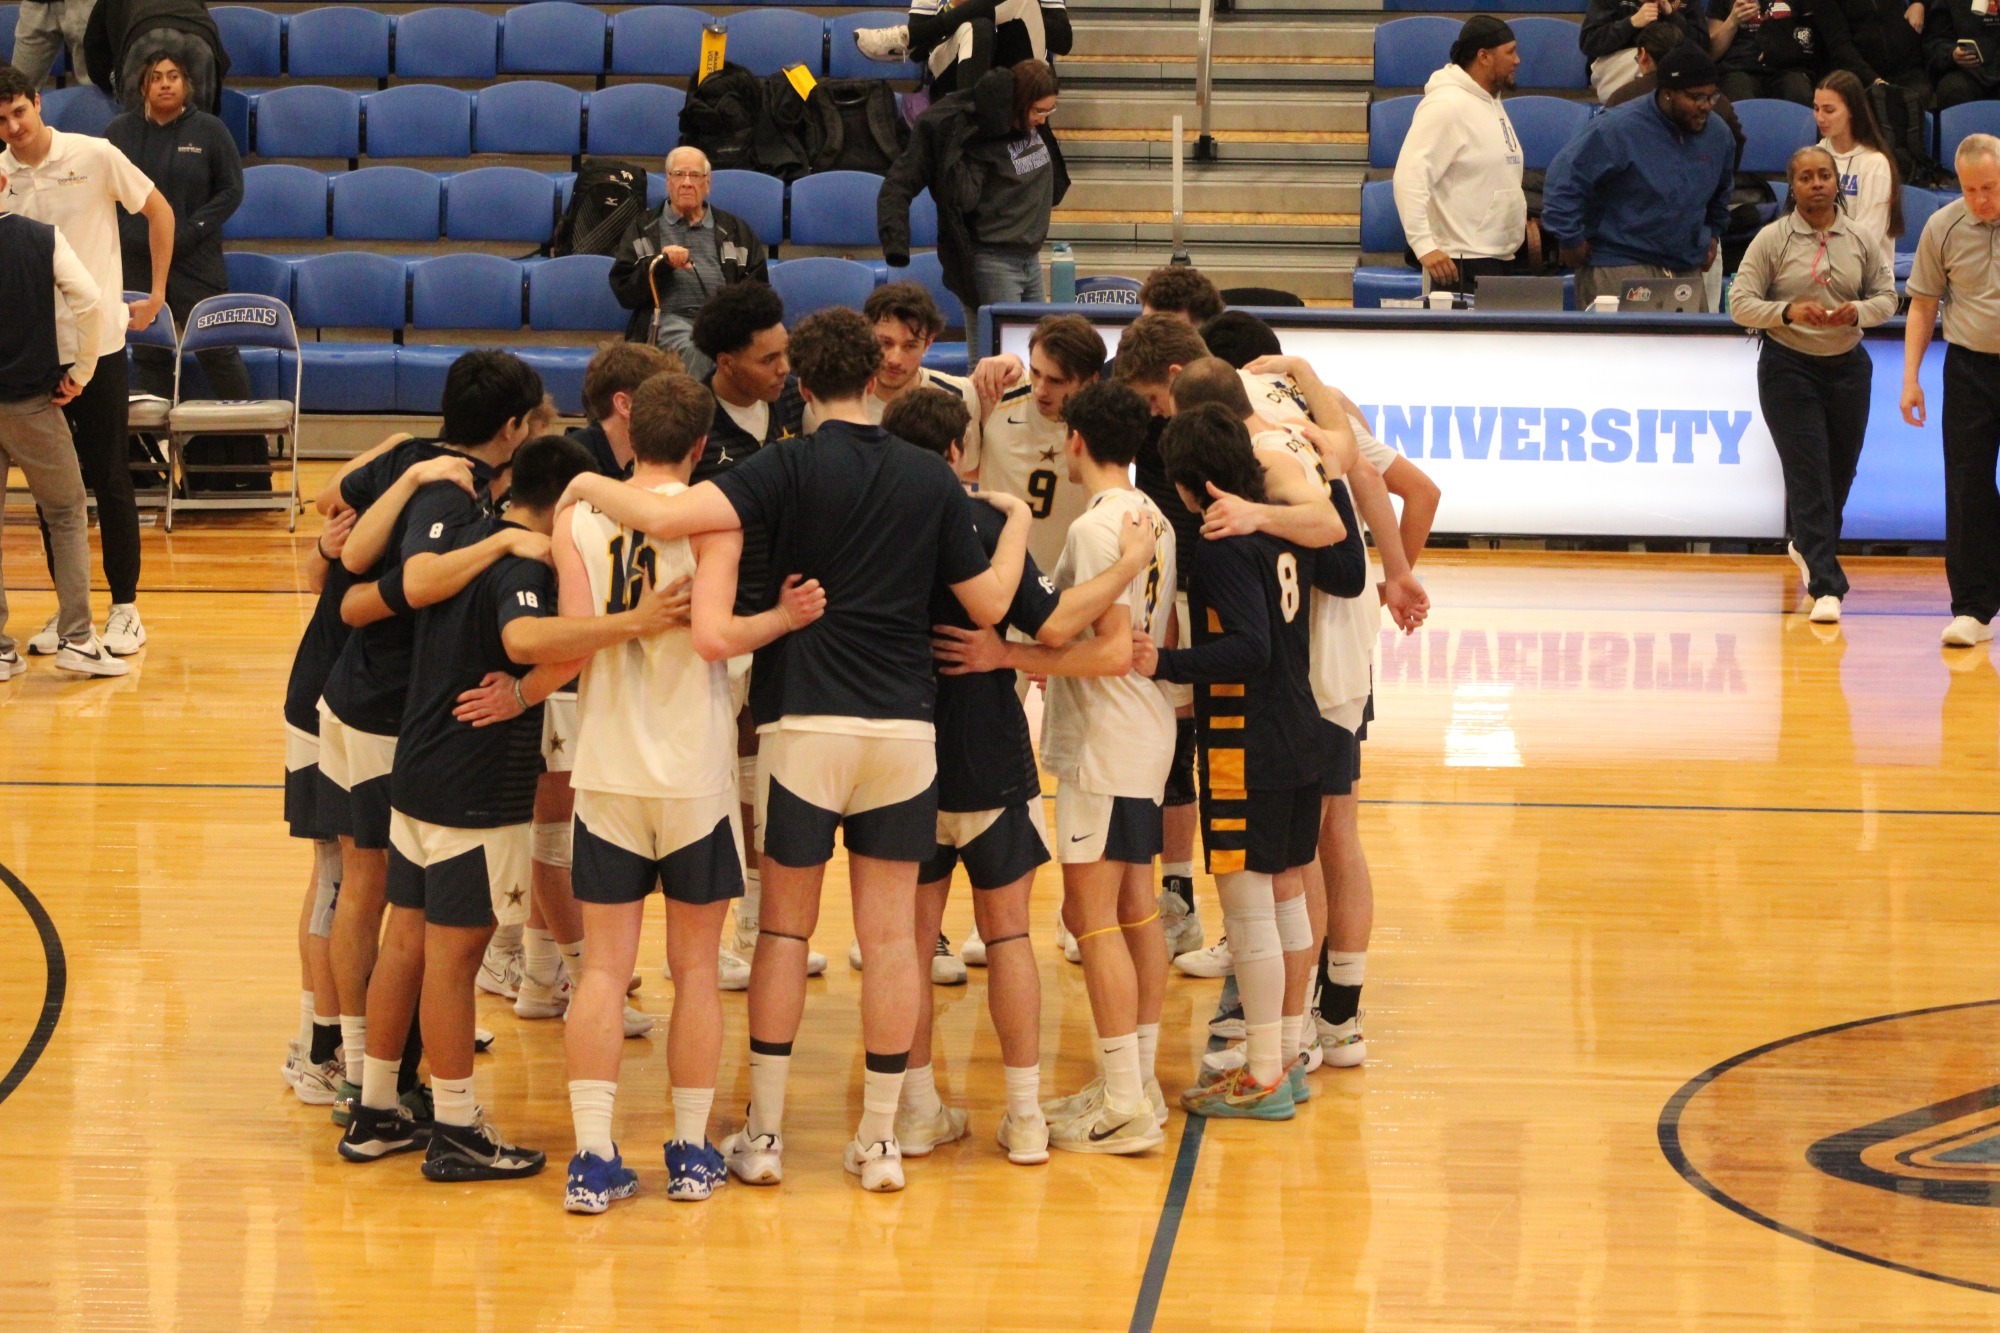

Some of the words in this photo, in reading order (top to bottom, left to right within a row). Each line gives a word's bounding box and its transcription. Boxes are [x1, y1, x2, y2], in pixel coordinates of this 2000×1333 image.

[1075, 289, 1137, 304] ARTANS
[197, 307, 277, 329] SPARTANS
[1026, 468, 1058, 520] 9
[1277, 551, 1300, 624] 8
